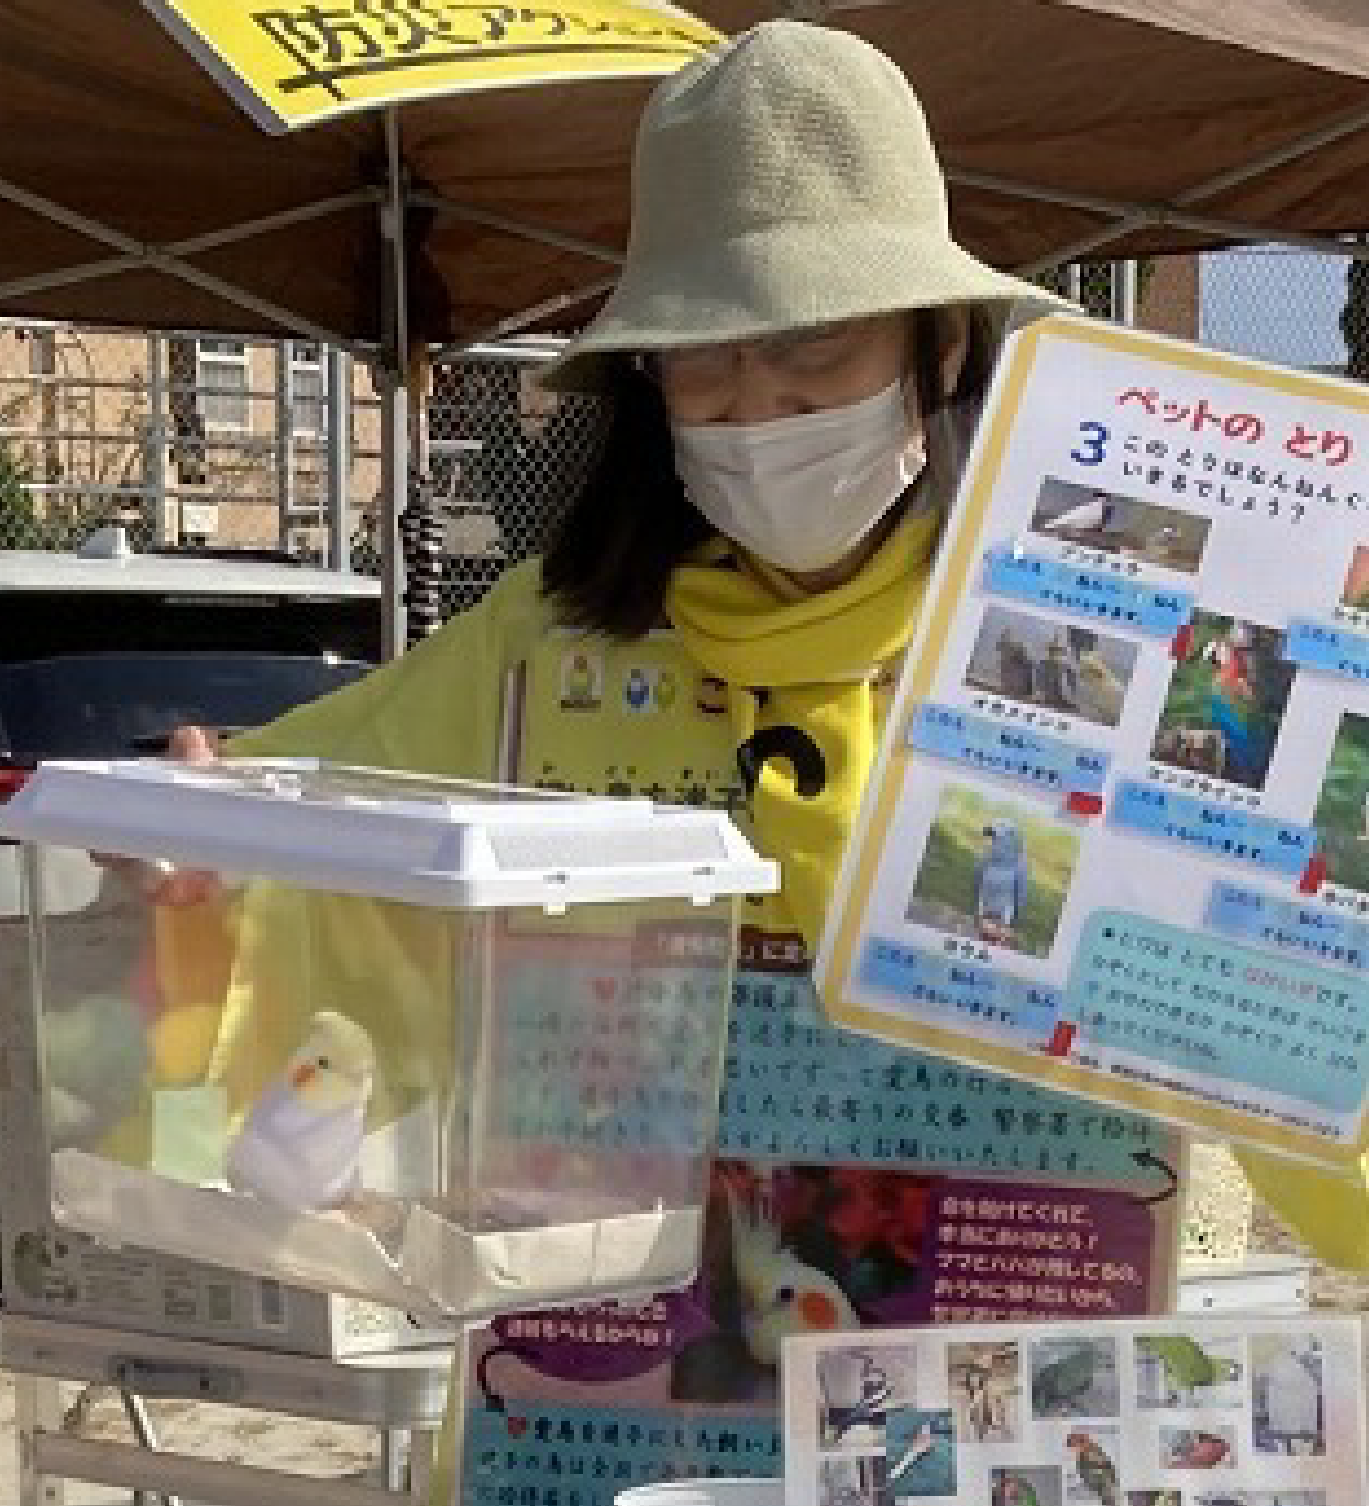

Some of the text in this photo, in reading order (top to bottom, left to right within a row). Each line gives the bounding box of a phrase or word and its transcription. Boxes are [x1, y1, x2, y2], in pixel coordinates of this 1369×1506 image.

[1070, 421, 1111, 468] 3
[1117, 385, 1264, 446] ペットの
[1284, 422, 1354, 466] とり
